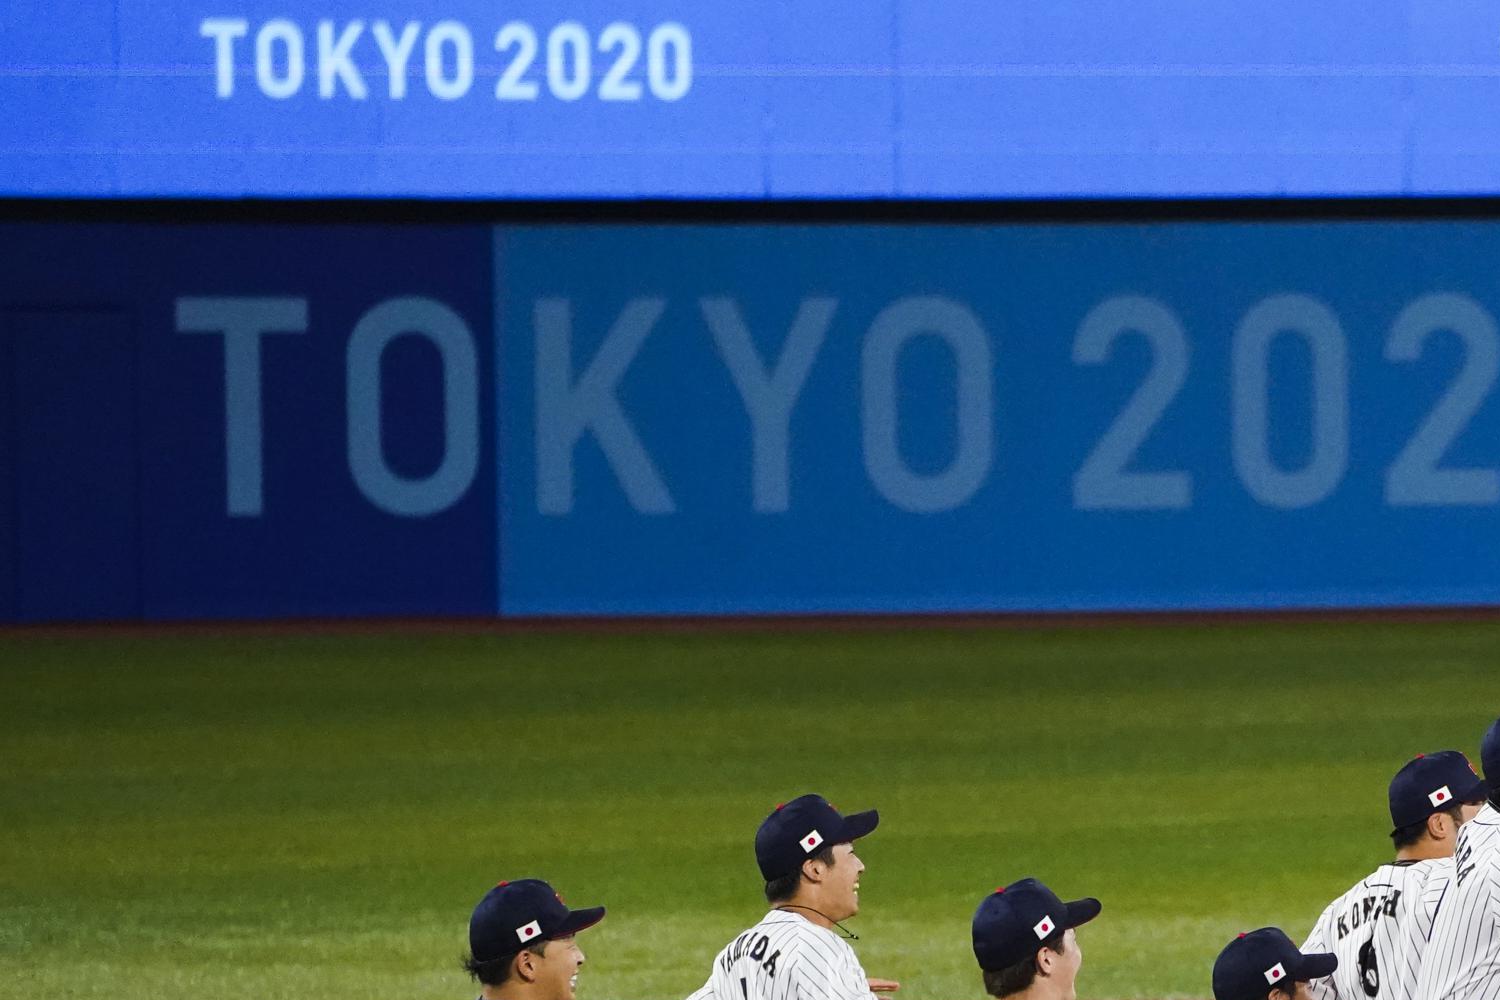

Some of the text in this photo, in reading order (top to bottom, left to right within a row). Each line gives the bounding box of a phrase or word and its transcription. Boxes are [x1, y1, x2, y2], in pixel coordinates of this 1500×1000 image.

[200, 18, 693, 101] TOKYO 2020
[175, 294, 994, 517] TOKYO
[720, 932, 781, 979] YAMADA
